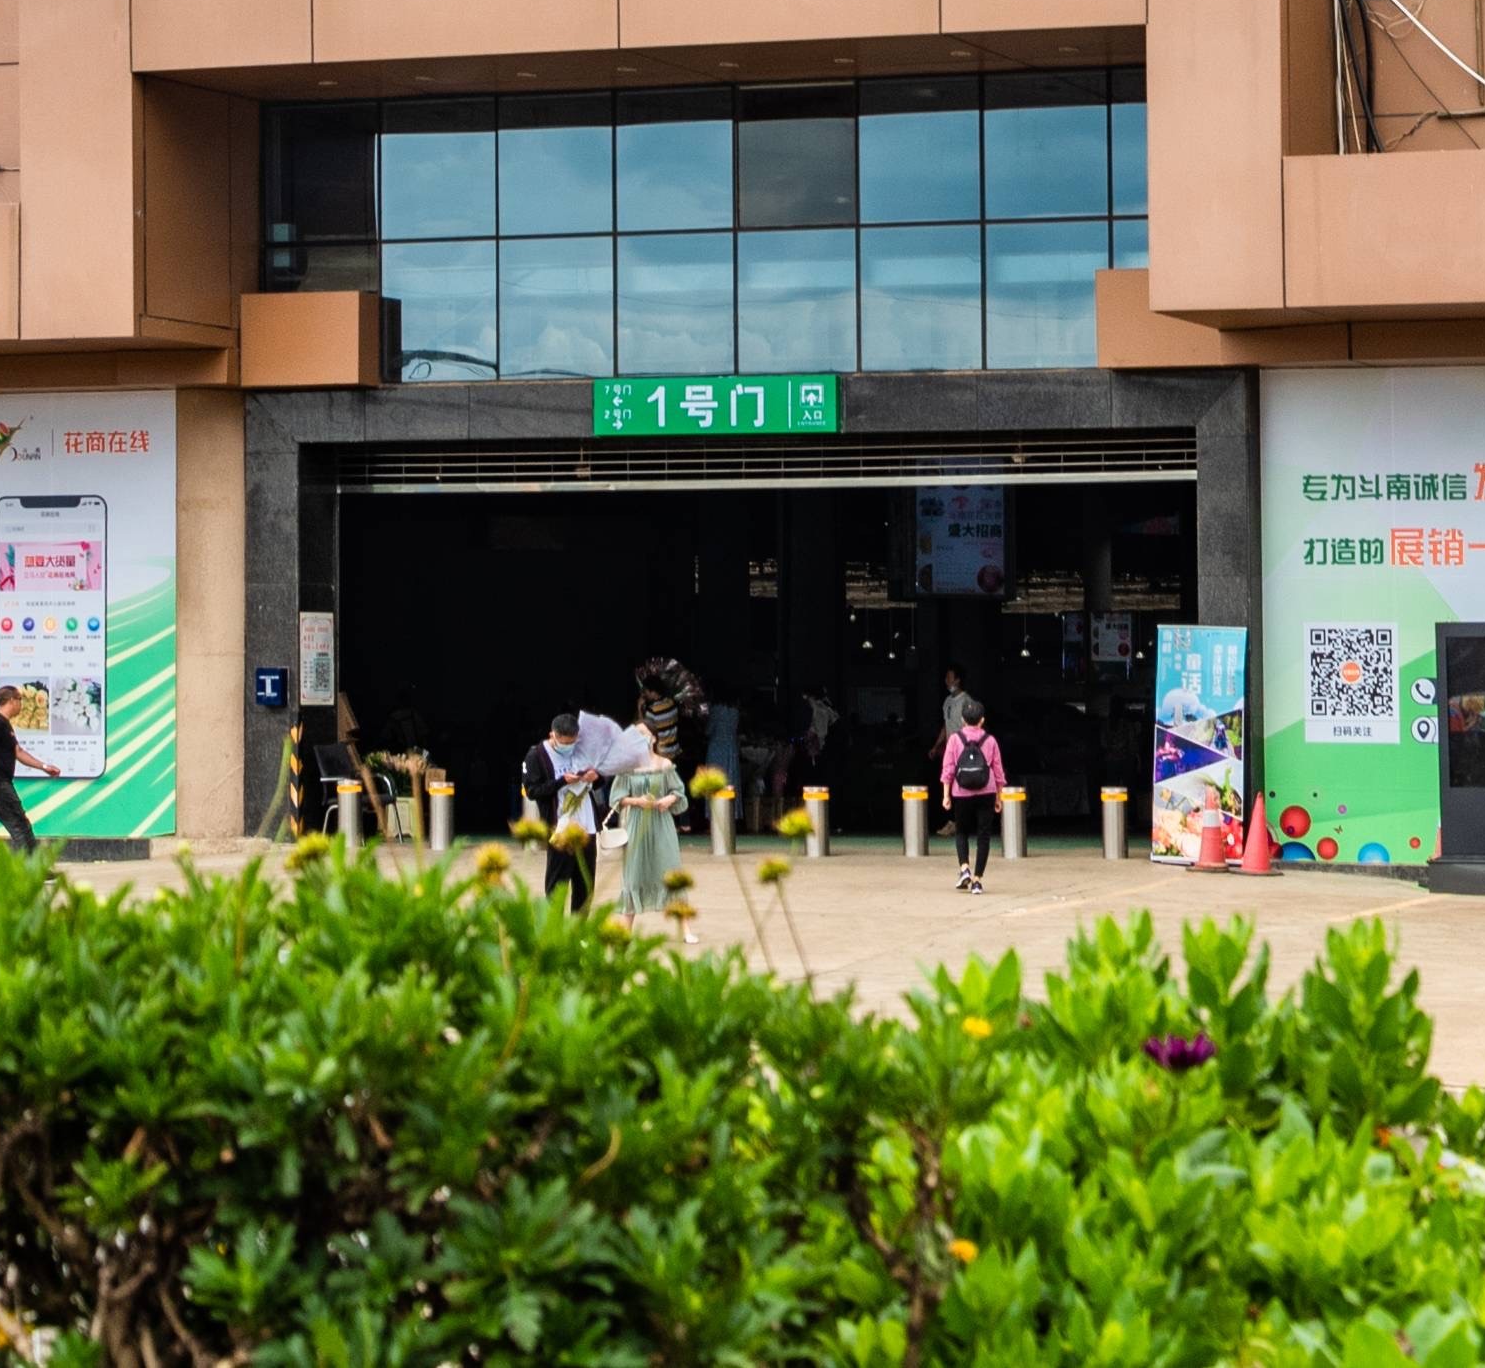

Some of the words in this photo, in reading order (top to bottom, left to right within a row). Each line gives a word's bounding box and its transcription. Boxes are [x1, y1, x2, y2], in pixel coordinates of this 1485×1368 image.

[604, 384, 632, 395] 7号门
[647, 383, 764, 428] 1号门
[604, 409, 632, 420] 2号门
[802, 410, 823, 421] 入口
[63, 430, 150, 454] 花商在线
[1333, 726, 1373, 738] 扫码关注
